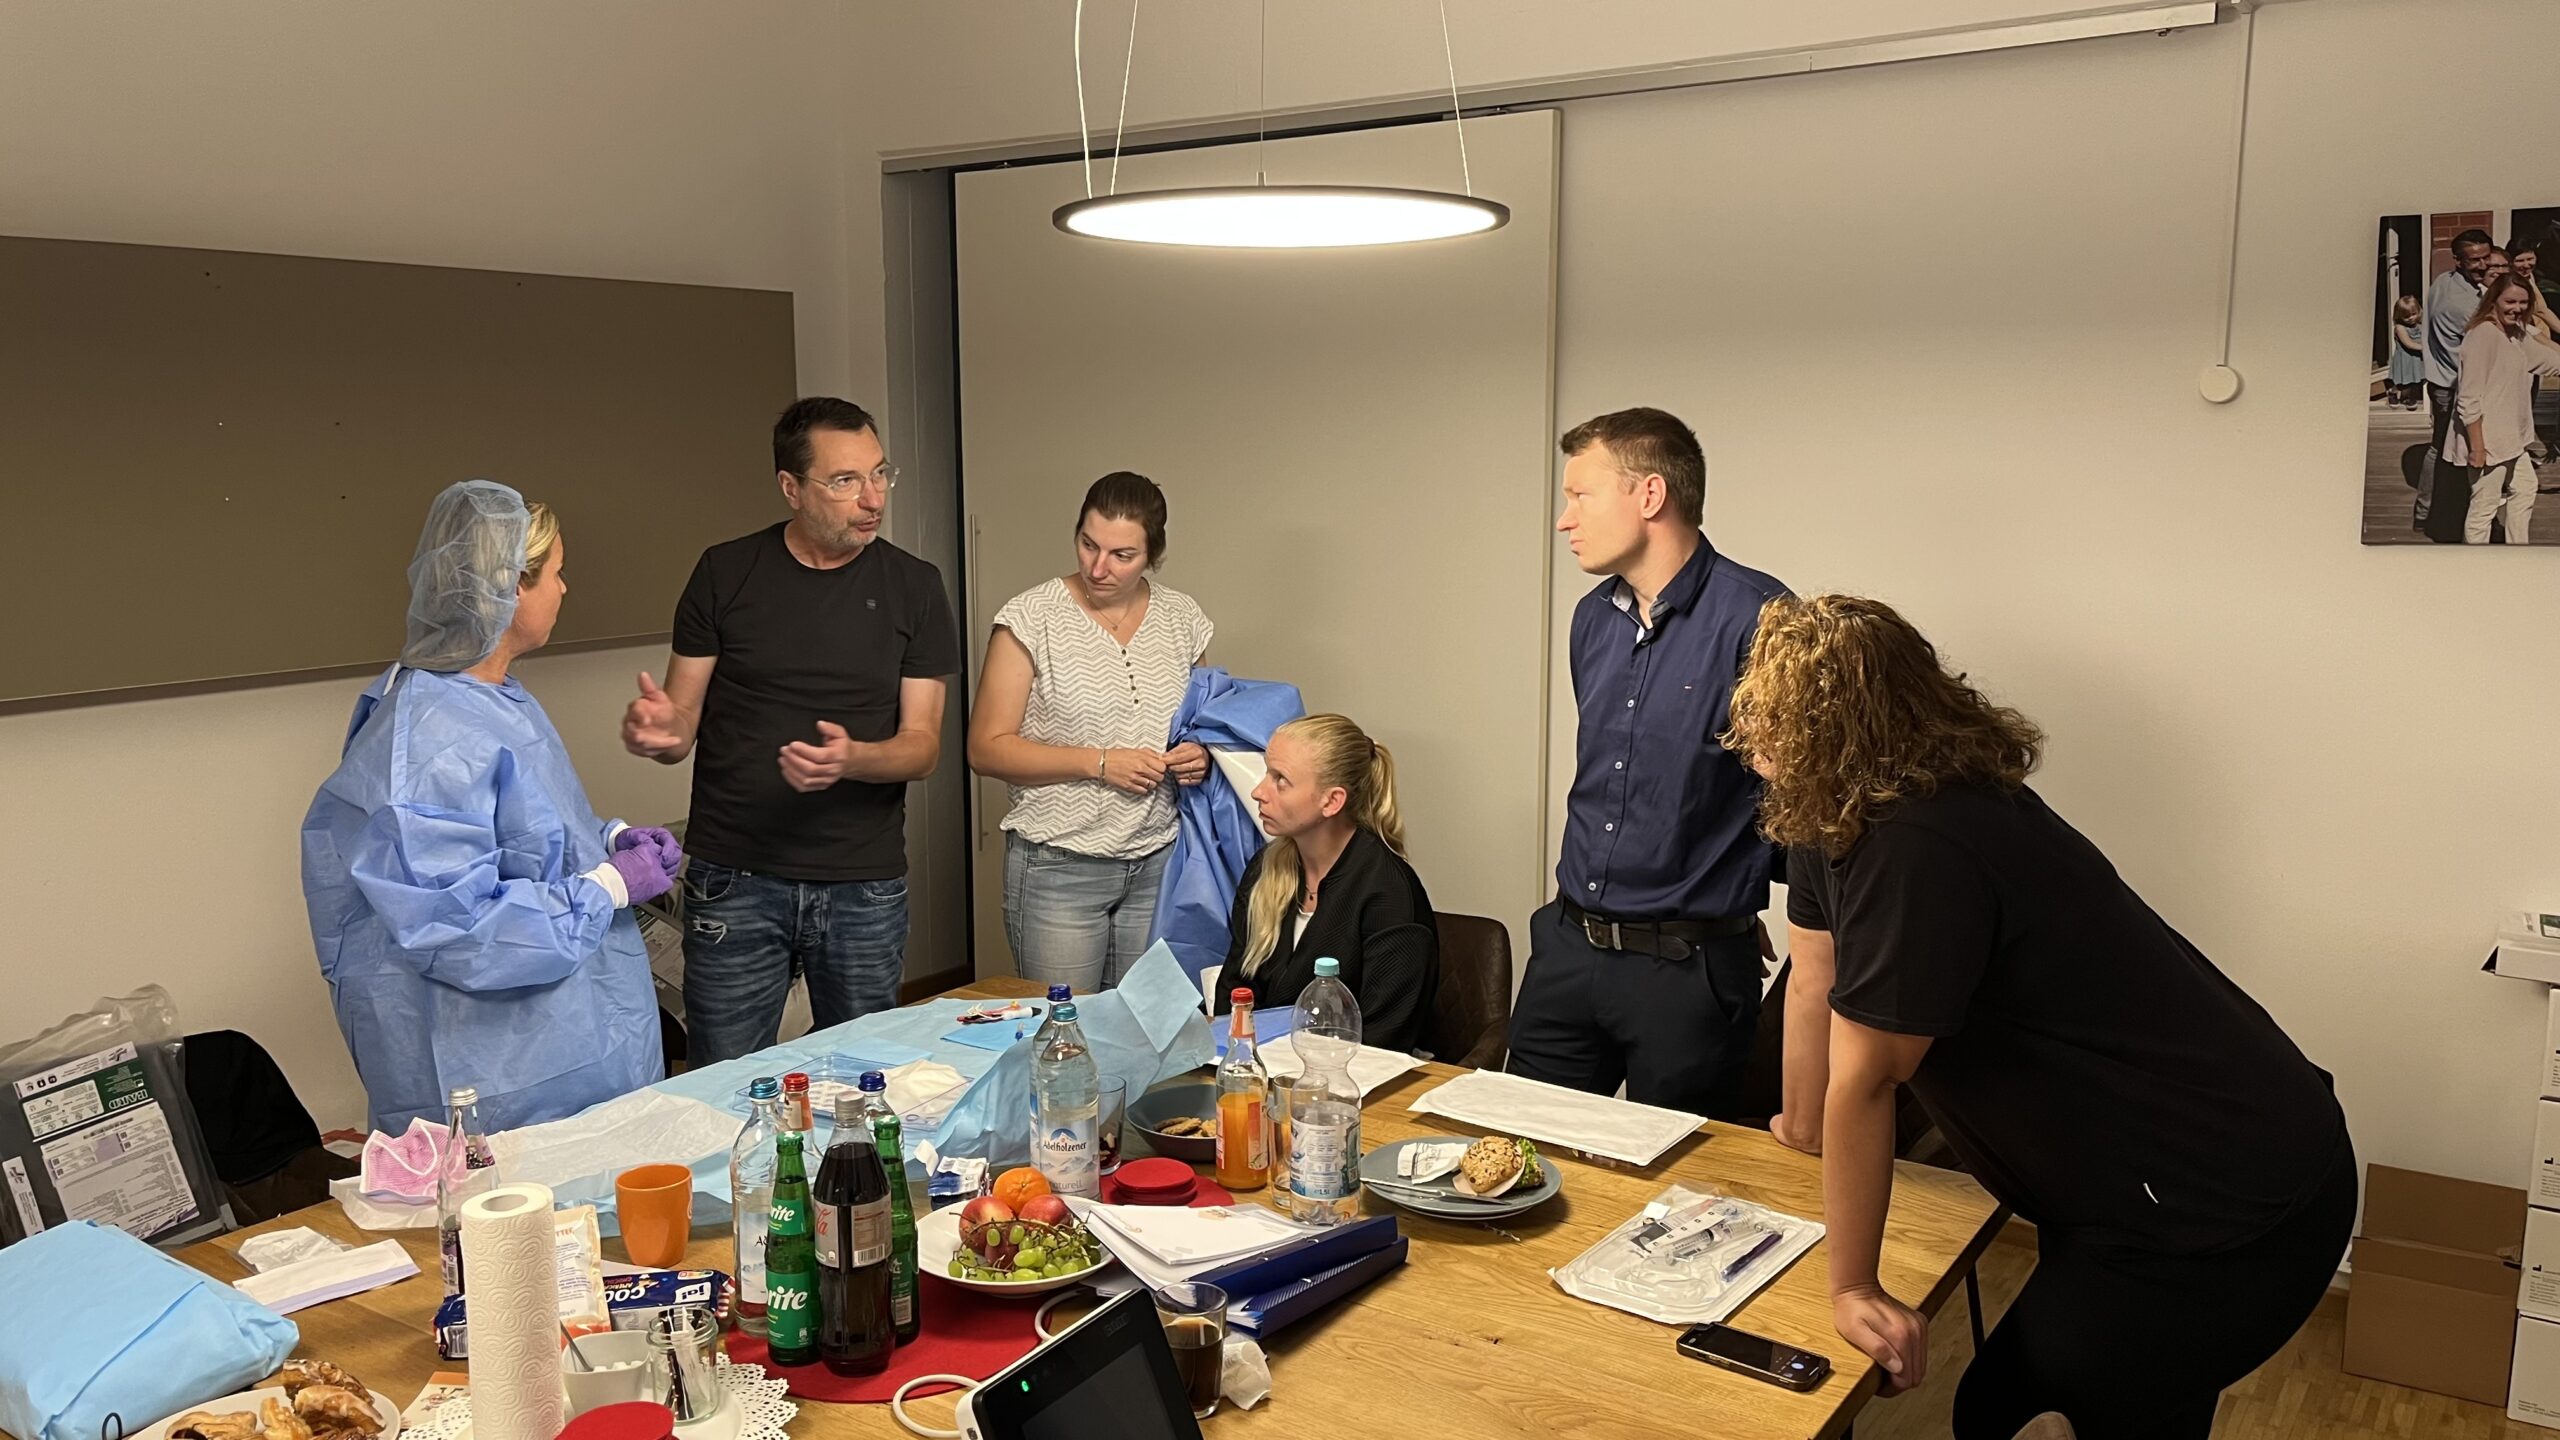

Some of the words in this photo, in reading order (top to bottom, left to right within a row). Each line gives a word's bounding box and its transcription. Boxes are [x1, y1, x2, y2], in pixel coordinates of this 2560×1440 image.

[1043, 1141, 1087, 1152] Adelholzener
[770, 1204, 795, 1222] rite
[604, 1286, 646, 1303] COO
[681, 1284, 705, 1301] ja!
[767, 1285, 808, 1311] rite
